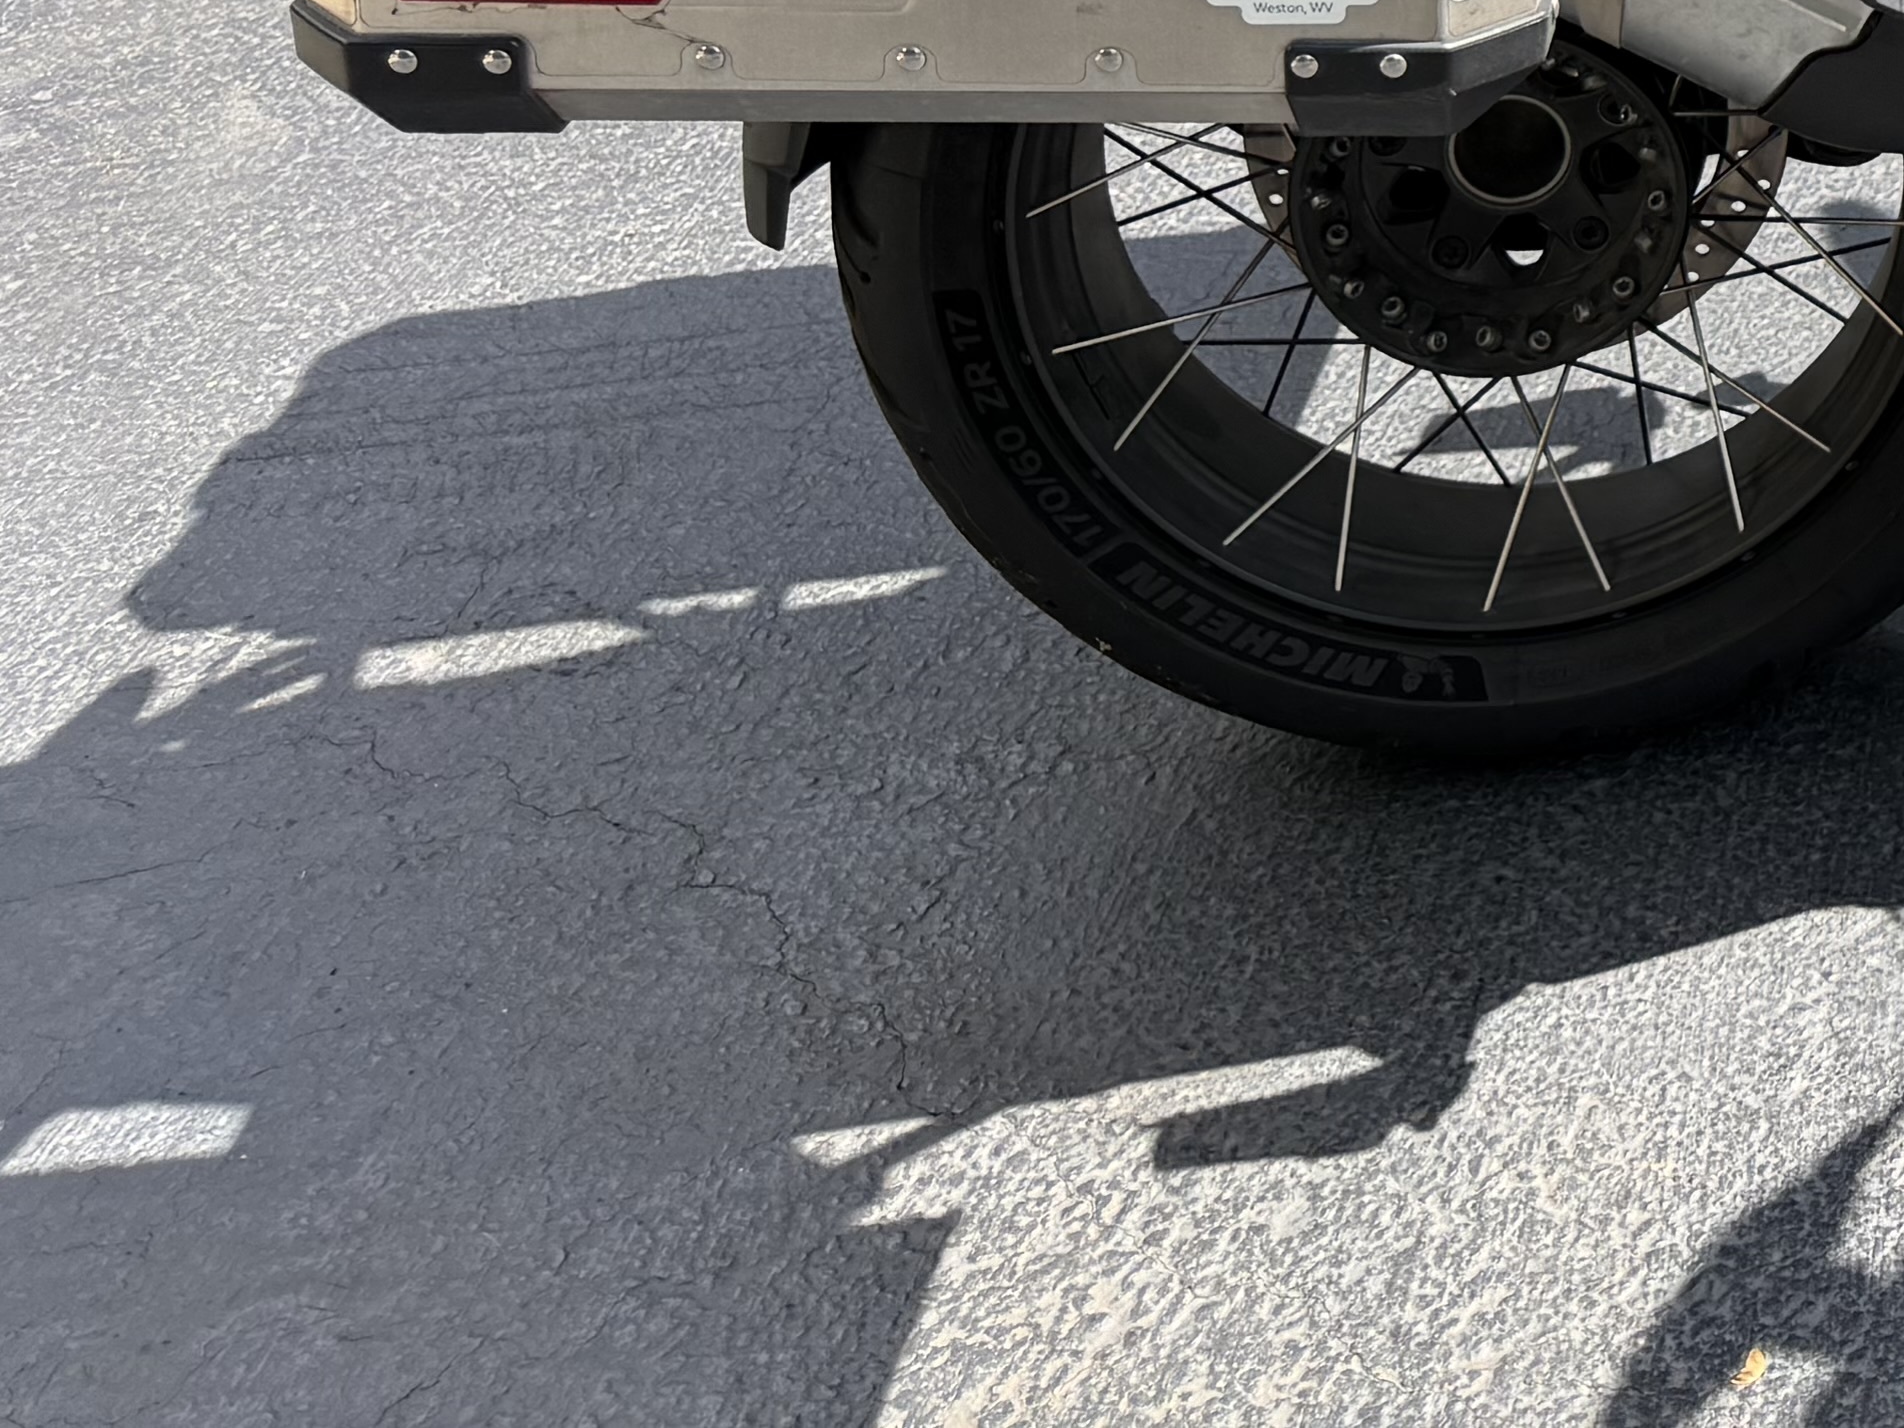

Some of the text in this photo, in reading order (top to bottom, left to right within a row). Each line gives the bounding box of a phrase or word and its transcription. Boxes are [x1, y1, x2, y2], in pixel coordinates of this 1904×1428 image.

[1254, 2, 1333, 15] Weston, WV
[945, 309, 1388, 688] MICHELIN 170/60 ZR 17
